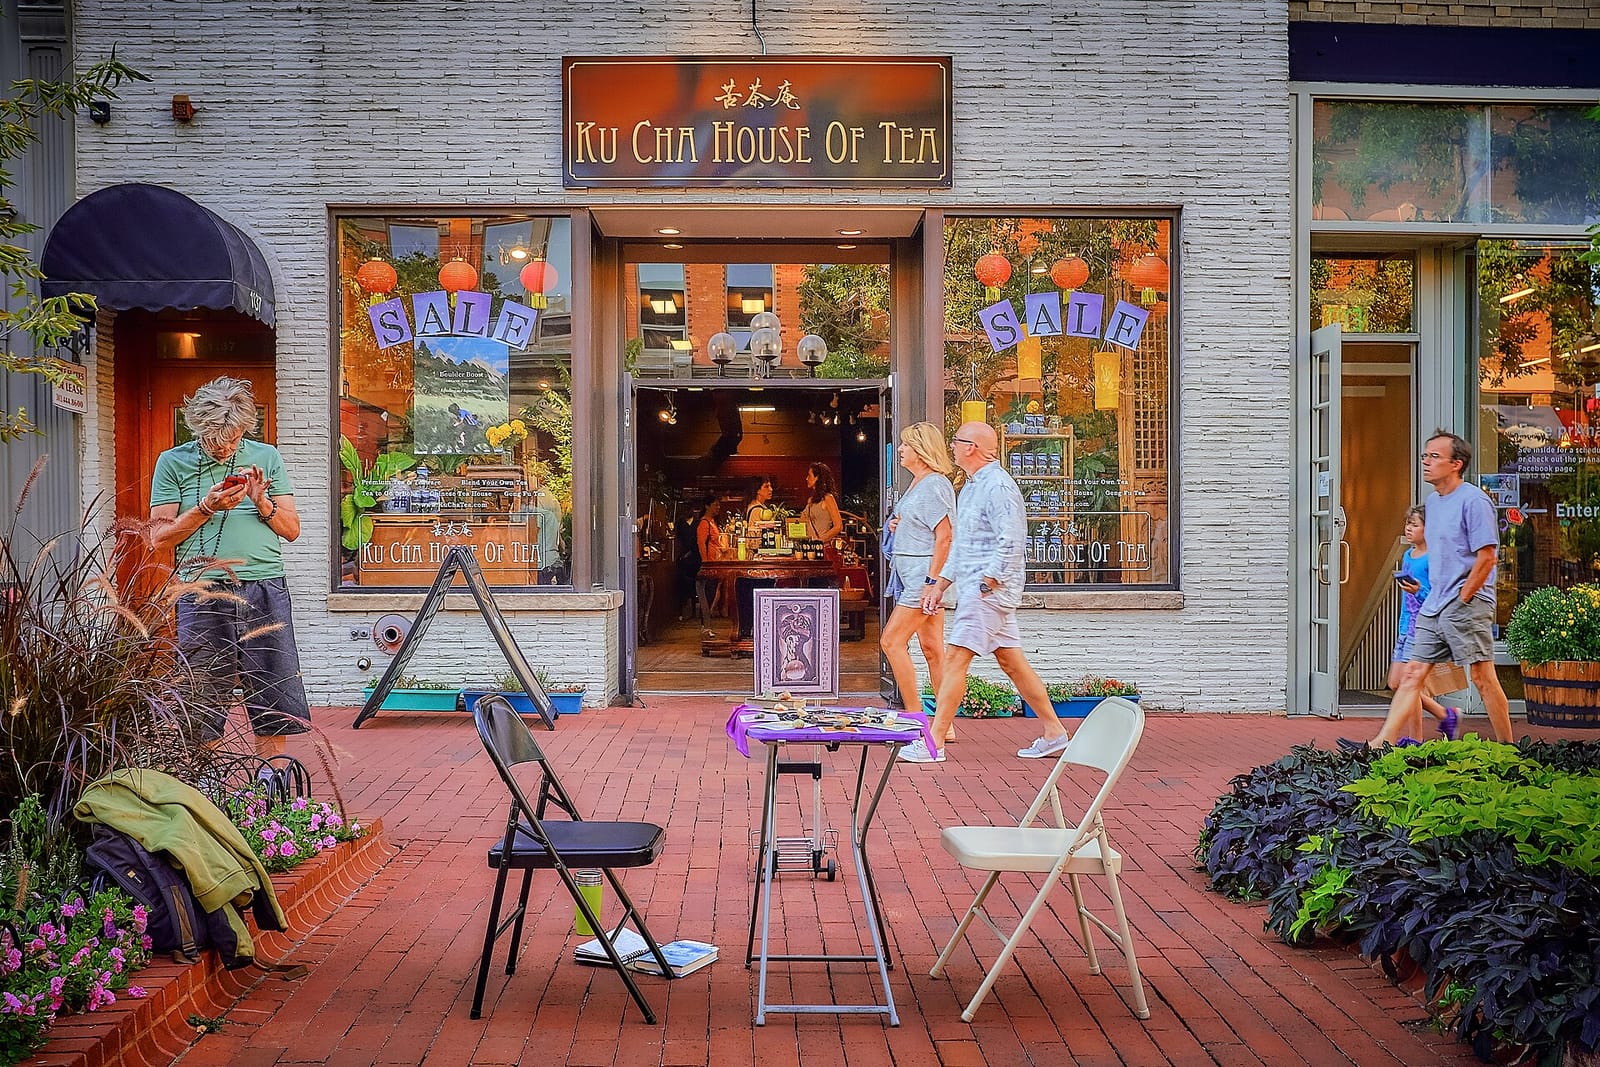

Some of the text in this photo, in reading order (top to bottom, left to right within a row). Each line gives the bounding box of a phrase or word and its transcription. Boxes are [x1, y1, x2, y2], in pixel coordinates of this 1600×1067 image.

[714, 77, 801, 110] 苦茶庵
[575, 119, 940, 164] KU CHA HOUSE OF TEA
[378, 301, 529, 348] SALE
[990, 302, 1140, 348] SALE
[1533, 446, 1555, 454] inside
[1556, 446, 1567, 454] for
[1555, 466, 1576, 474] page.
[1556, 503, 1600, 518] Enter
[362, 541, 384, 564] KU
[390, 541, 422, 564] CHA
[484, 541, 505, 564] OF
[511, 542, 542, 564] TEA
[1036, 542, 1085, 563] HOUSE
[1091, 541, 1111, 563] OF
[1117, 541, 1148, 563] TEA
[374, 637, 388, 651] AUTO
